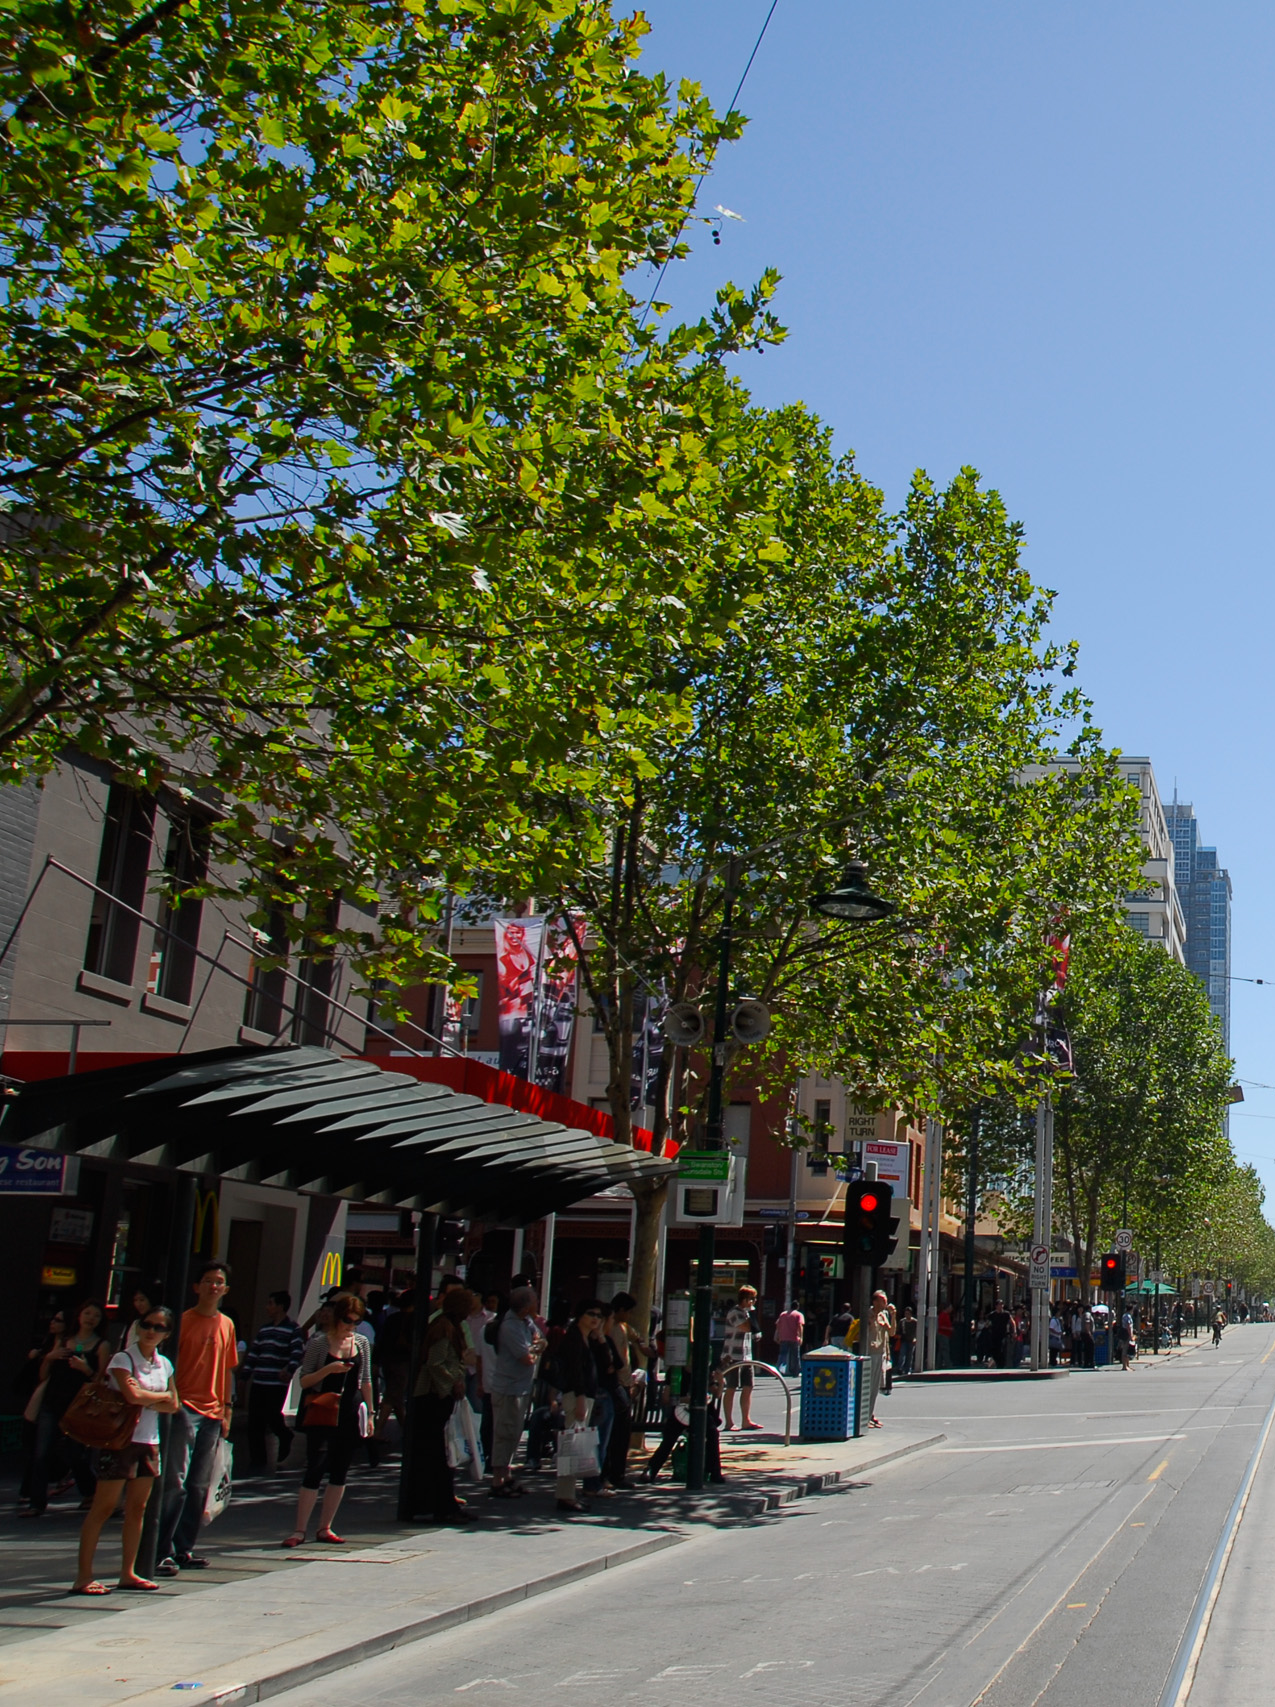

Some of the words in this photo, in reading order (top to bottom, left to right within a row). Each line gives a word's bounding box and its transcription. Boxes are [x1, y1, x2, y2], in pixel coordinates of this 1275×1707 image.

[849, 1117, 876, 1126] RIGHT
[850, 1127, 875, 1136] TURN
[867, 1145, 879, 1153] FOR
[880, 1146, 898, 1155] LEASE
[16, 1149, 62, 1170] Son
[15, 1178, 60, 1186] restaurant
[1118, 1235, 1129, 1244] 30
[1033, 1266, 1045, 1274] NO
